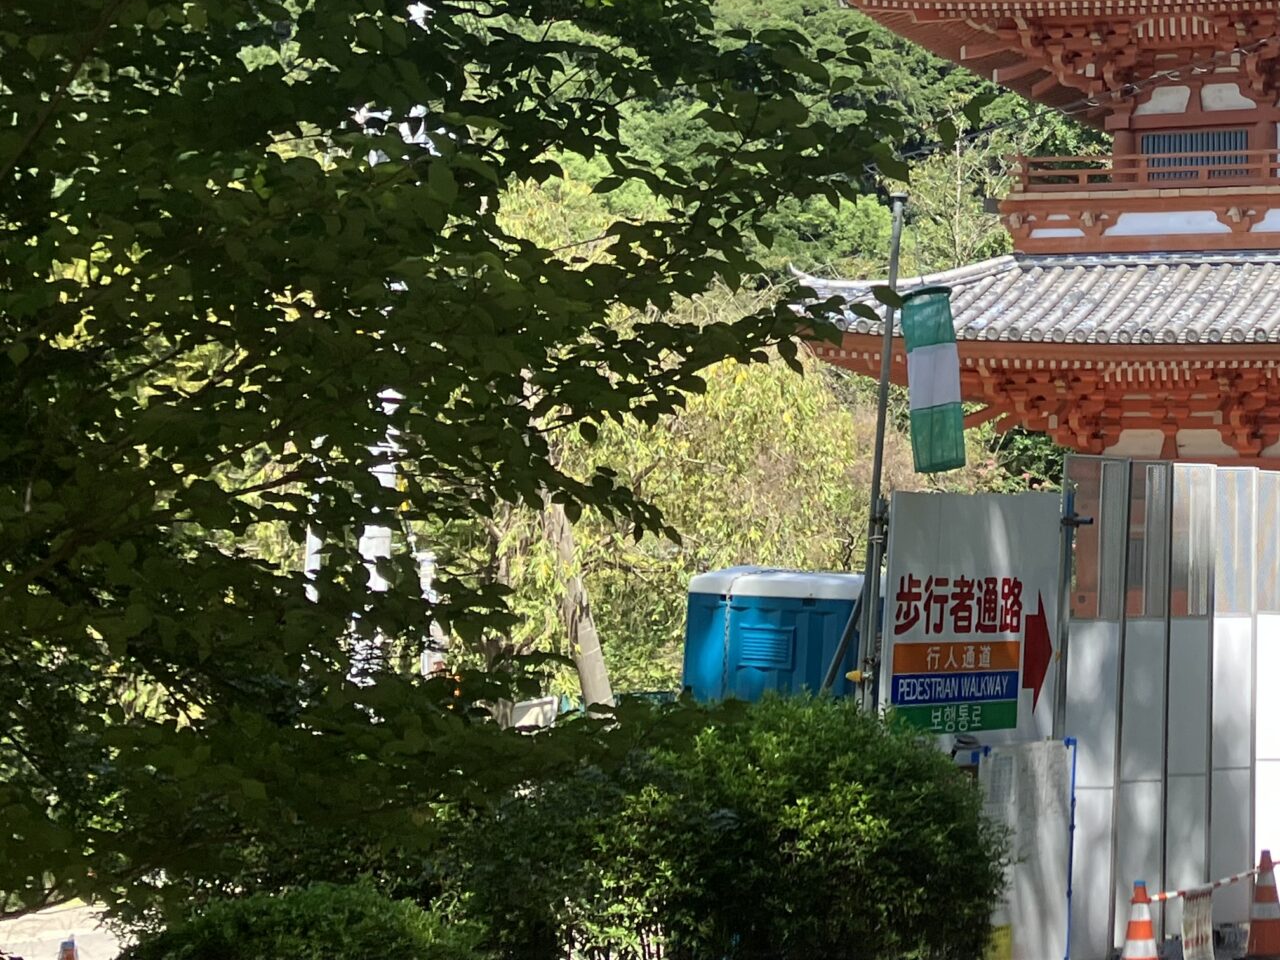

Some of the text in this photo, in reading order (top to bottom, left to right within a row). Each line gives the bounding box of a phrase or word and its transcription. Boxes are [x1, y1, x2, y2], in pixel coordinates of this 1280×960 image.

[894, 573, 1023, 635] 歩行者通路
[926, 646, 992, 670] 行人通道
[898, 677, 1009, 702] PEDESTRIAN WALKWAY
[930, 704, 983, 731] 보행통로
